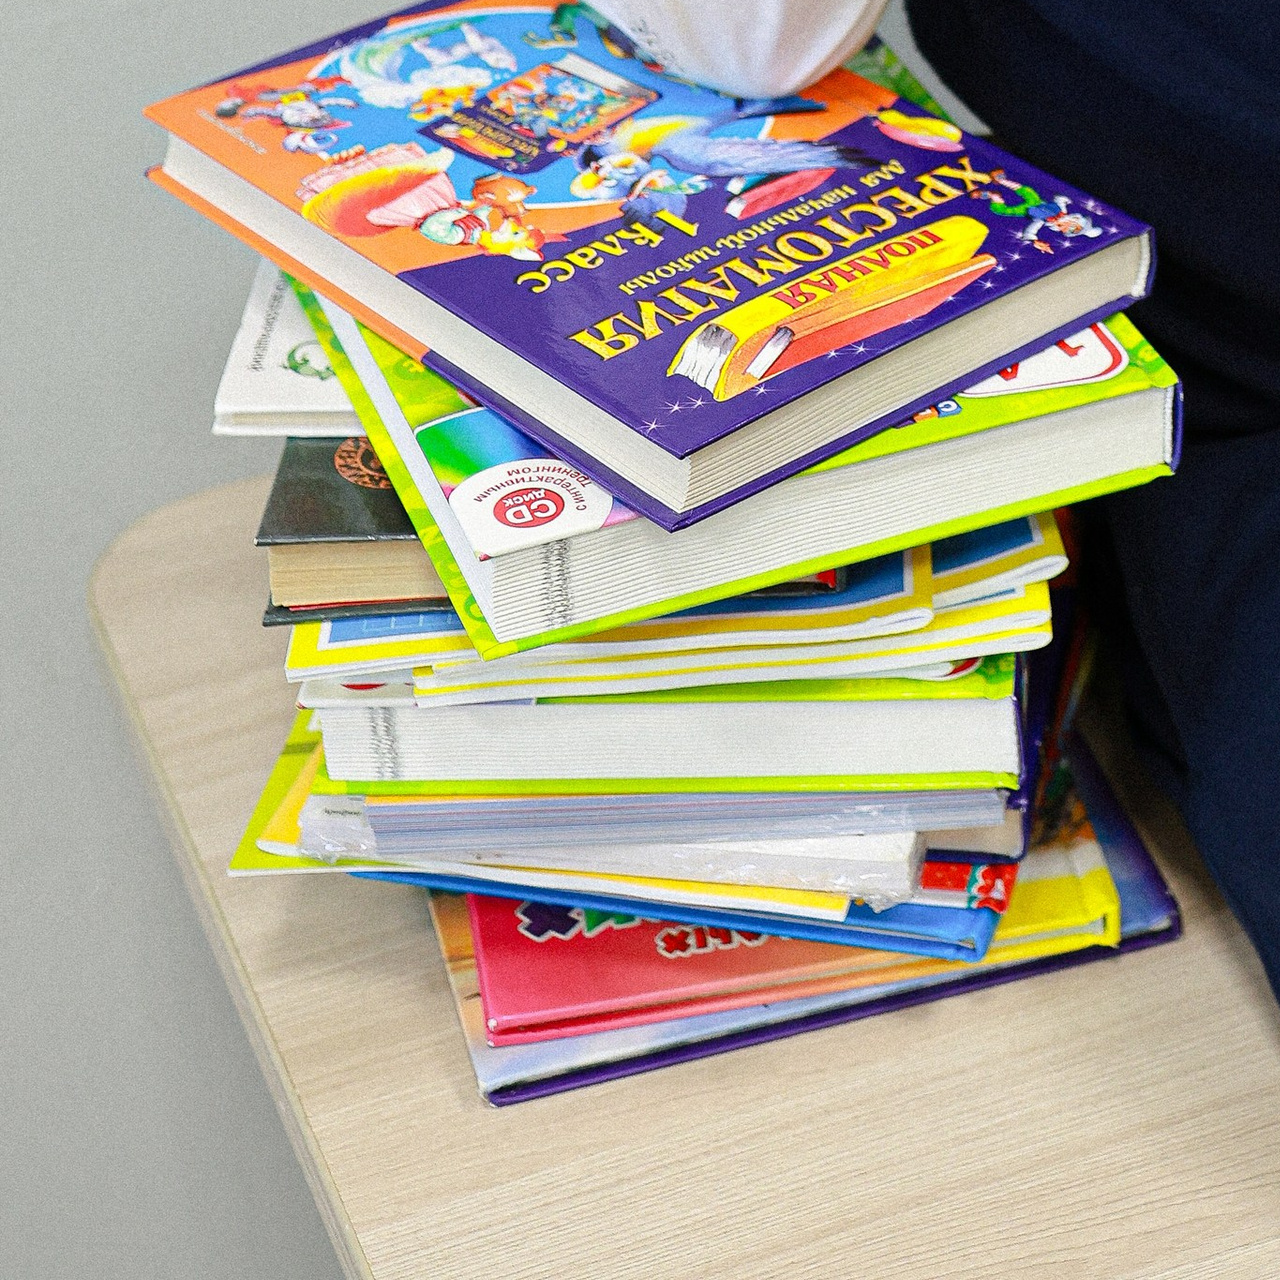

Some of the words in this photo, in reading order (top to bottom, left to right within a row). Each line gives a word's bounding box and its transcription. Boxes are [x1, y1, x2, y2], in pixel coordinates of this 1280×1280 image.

[859, 159, 906, 188] для
[654, 209, 698, 237] 1
[726, 184, 857, 250] начальной
[568, 156, 993, 360] ХРЕСТОМАТИЯ
[619, 237, 727, 295] школы
[768, 229, 943, 310] ПОЛНАЯ
[473, 474, 584, 504] интерактивным
[504, 499, 557, 524] CD
